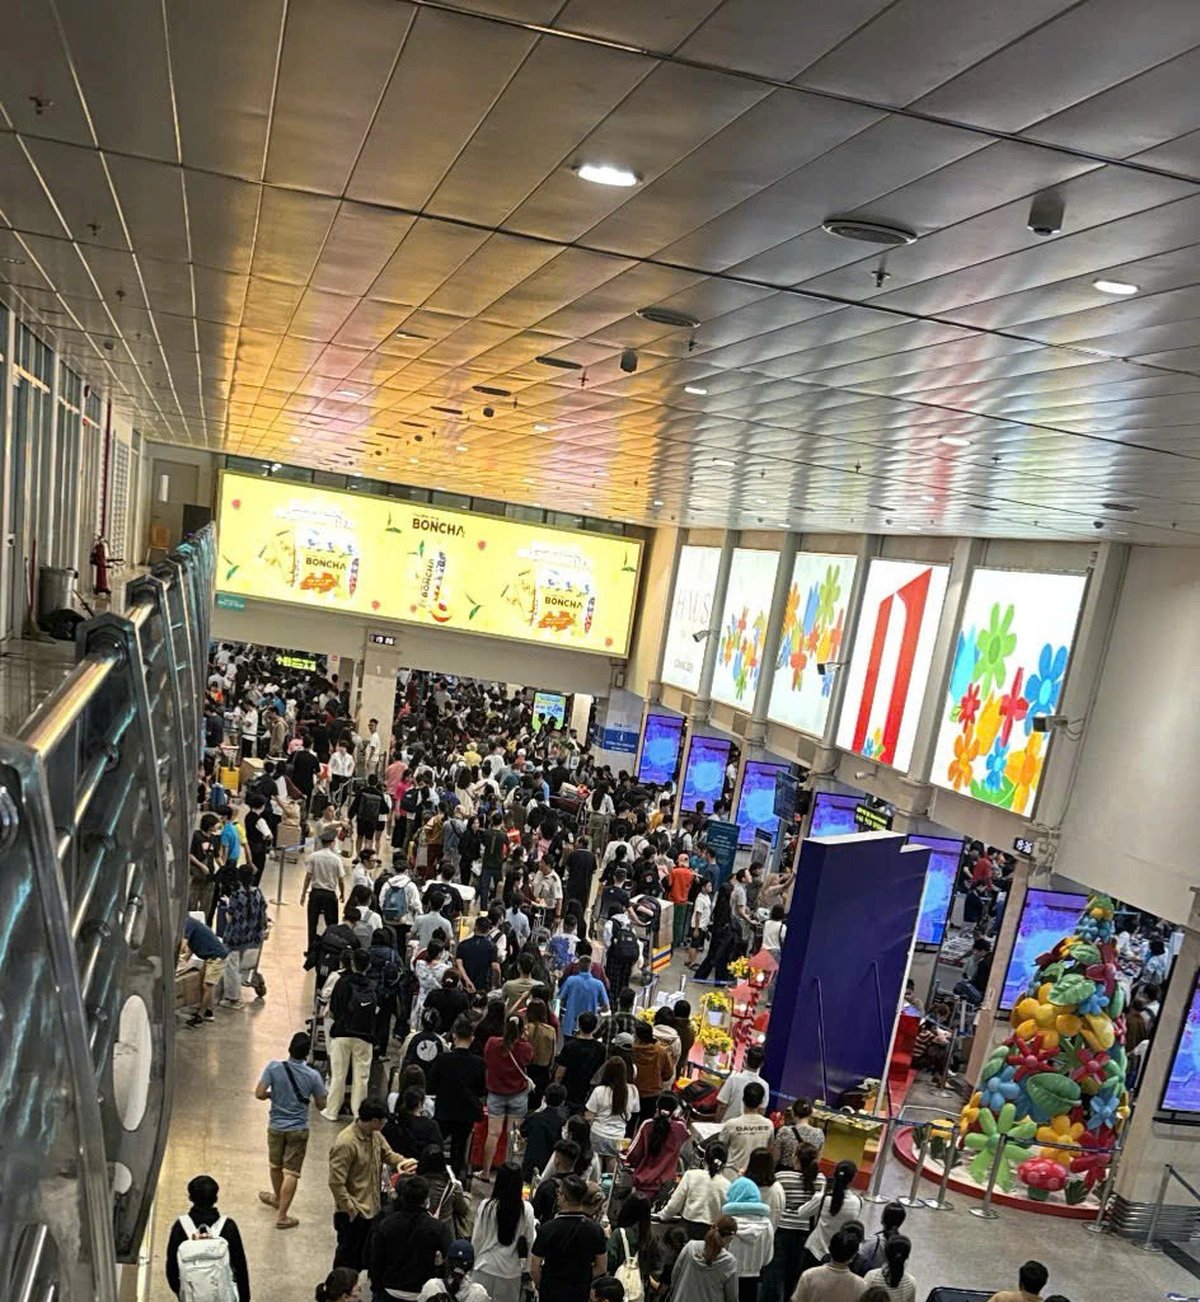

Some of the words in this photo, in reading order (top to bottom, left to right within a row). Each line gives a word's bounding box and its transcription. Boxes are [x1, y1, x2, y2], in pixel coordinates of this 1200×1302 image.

[412, 518, 465, 537] BONCHA
[305, 557, 347, 571] BONCHA
[545, 596, 583, 609] BONCHA
